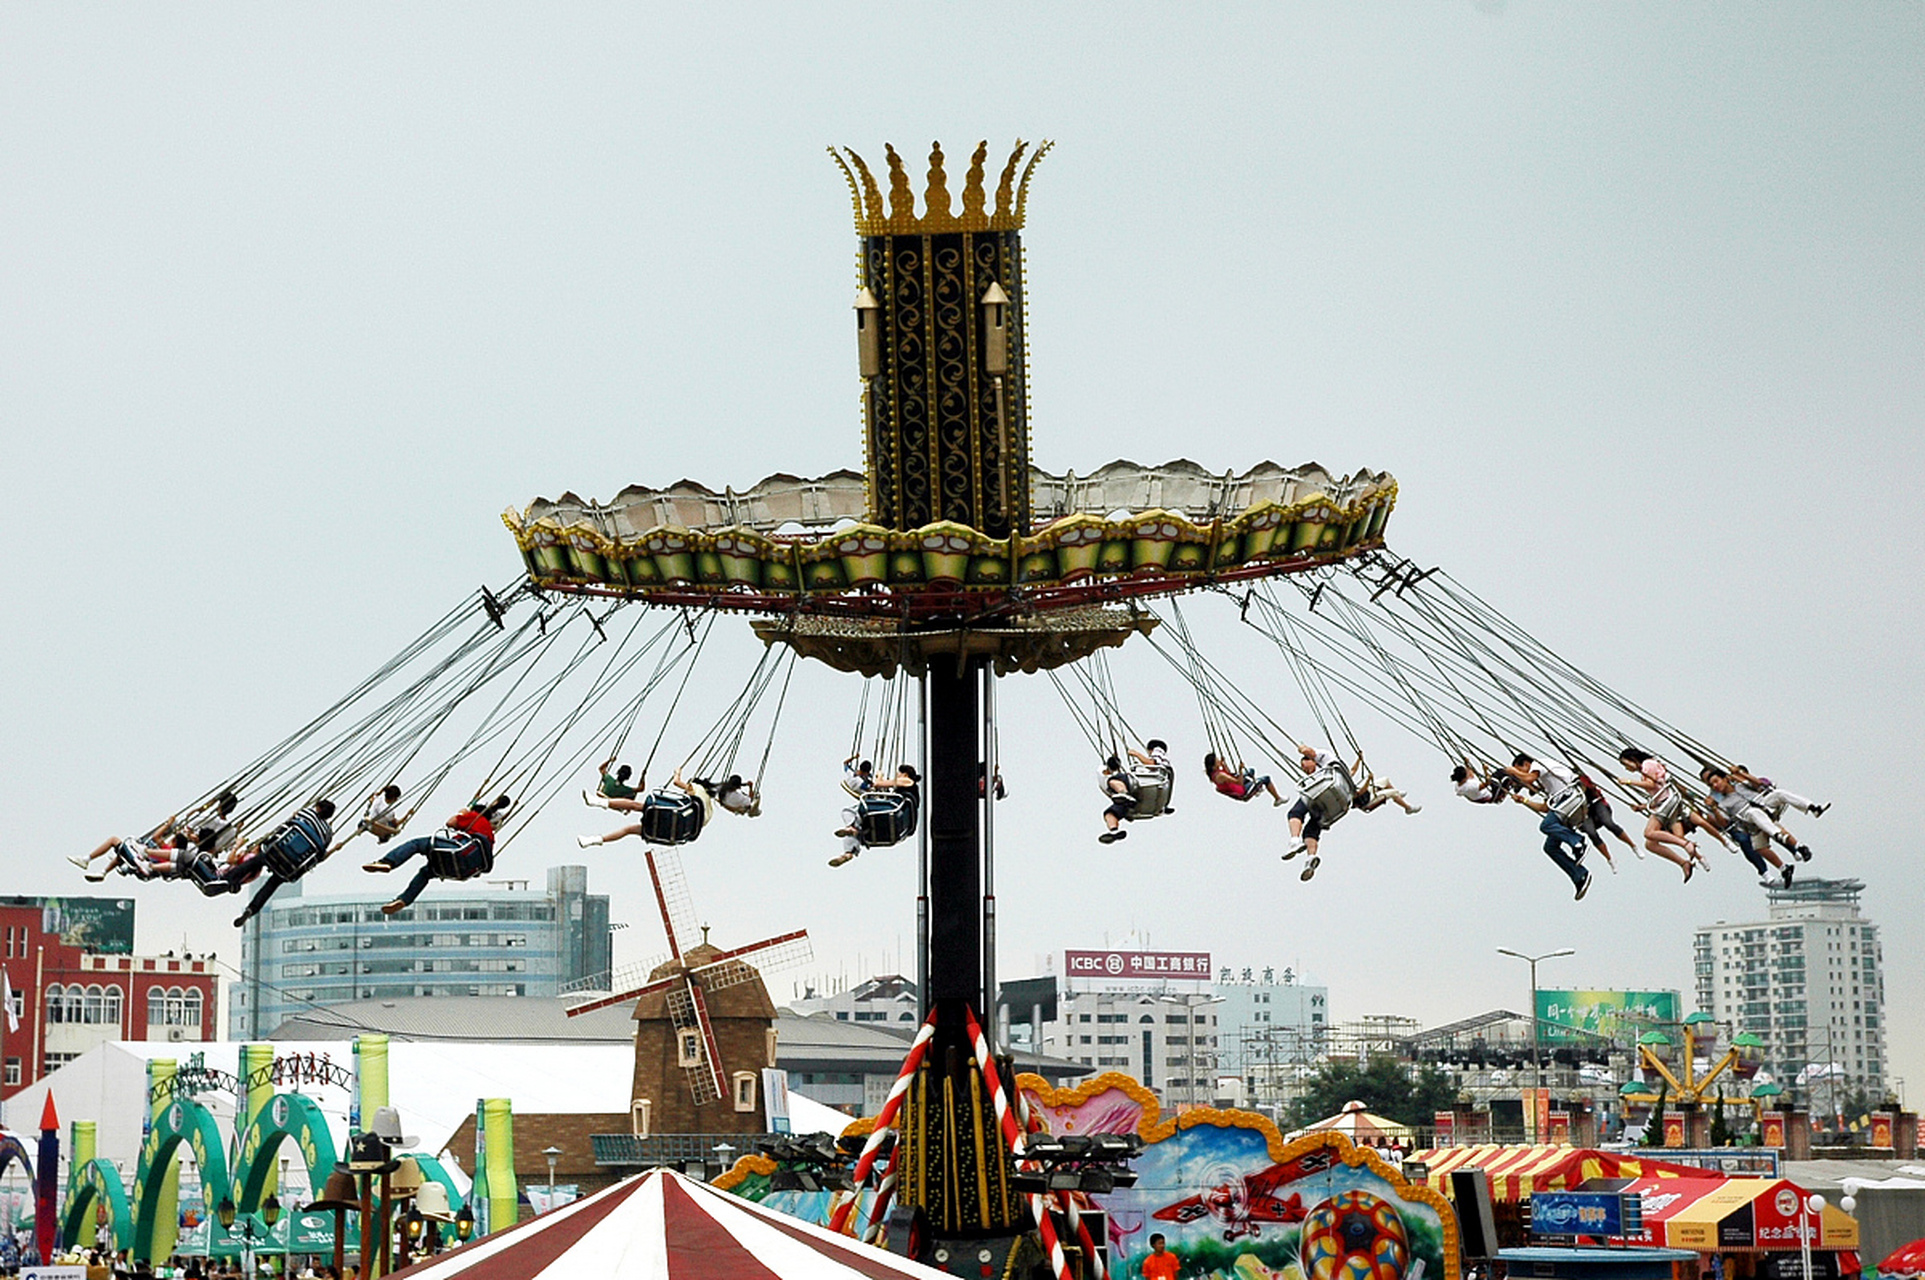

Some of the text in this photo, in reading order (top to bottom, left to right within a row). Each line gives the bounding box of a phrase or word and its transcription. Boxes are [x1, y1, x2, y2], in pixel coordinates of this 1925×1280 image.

[1071, 957, 1103, 970] ICBC
[1130, 955, 1209, 973] 中国工商银行
